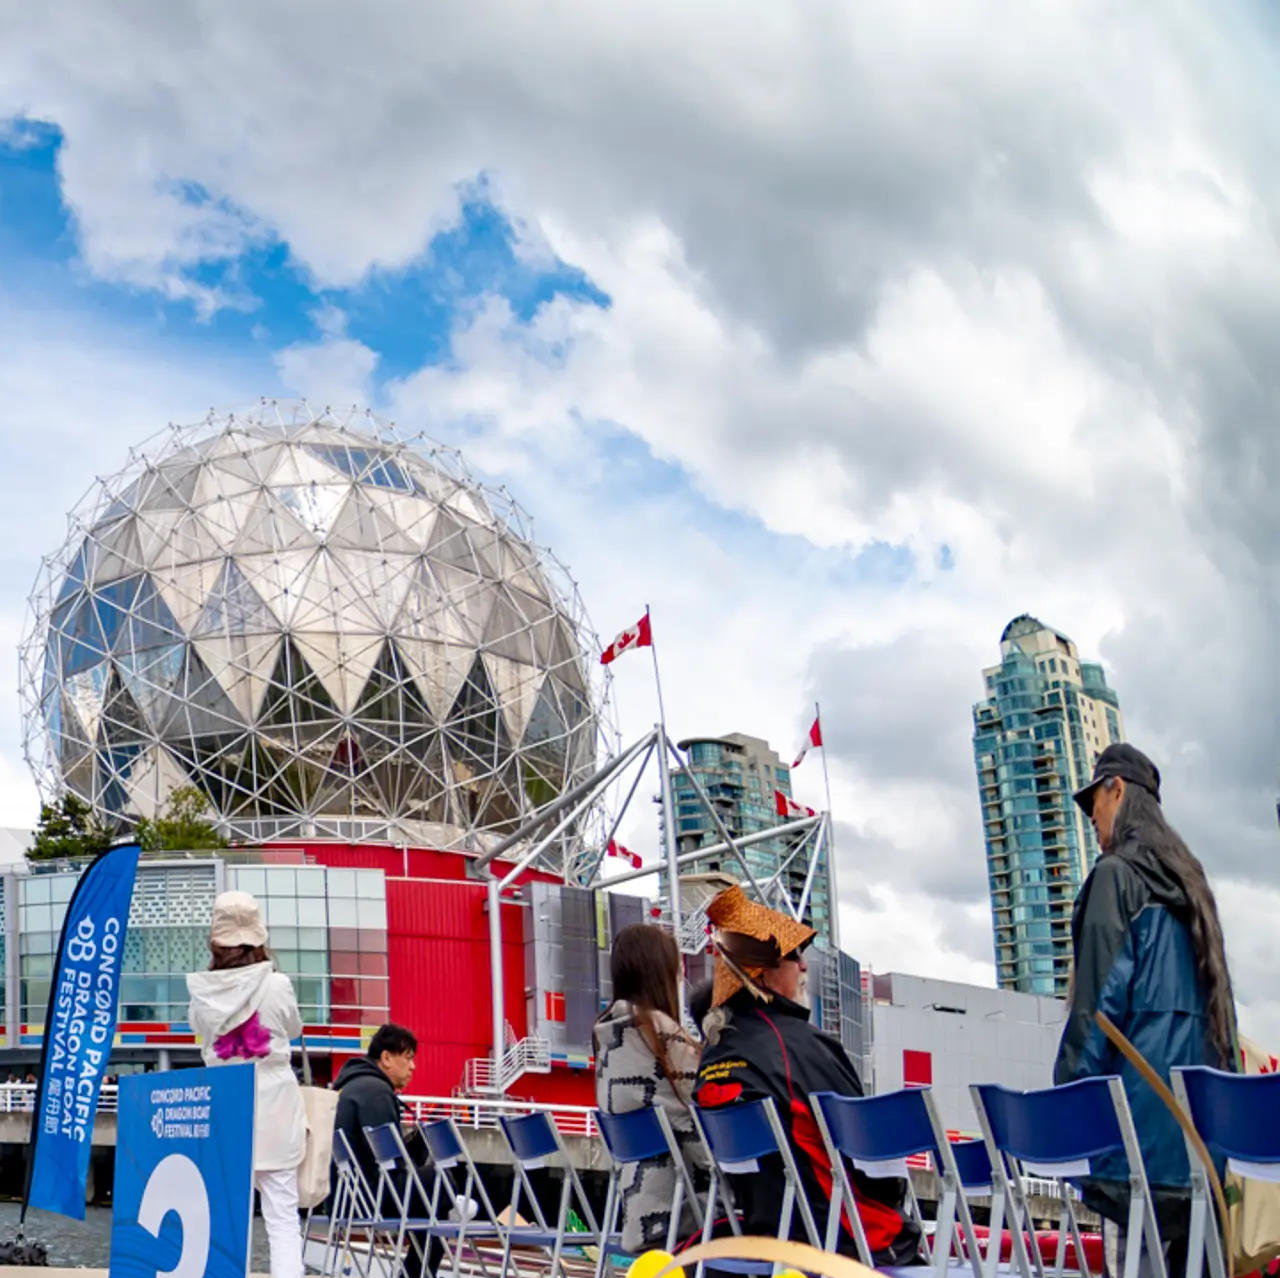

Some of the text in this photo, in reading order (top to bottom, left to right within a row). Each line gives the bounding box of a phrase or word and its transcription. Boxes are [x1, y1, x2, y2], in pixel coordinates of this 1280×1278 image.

[50, 967, 76, 1074] FESTIVAL
[61, 971, 91, 1140] DRAGON BOAT
[73, 1048, 103, 1143] PACIFIC
